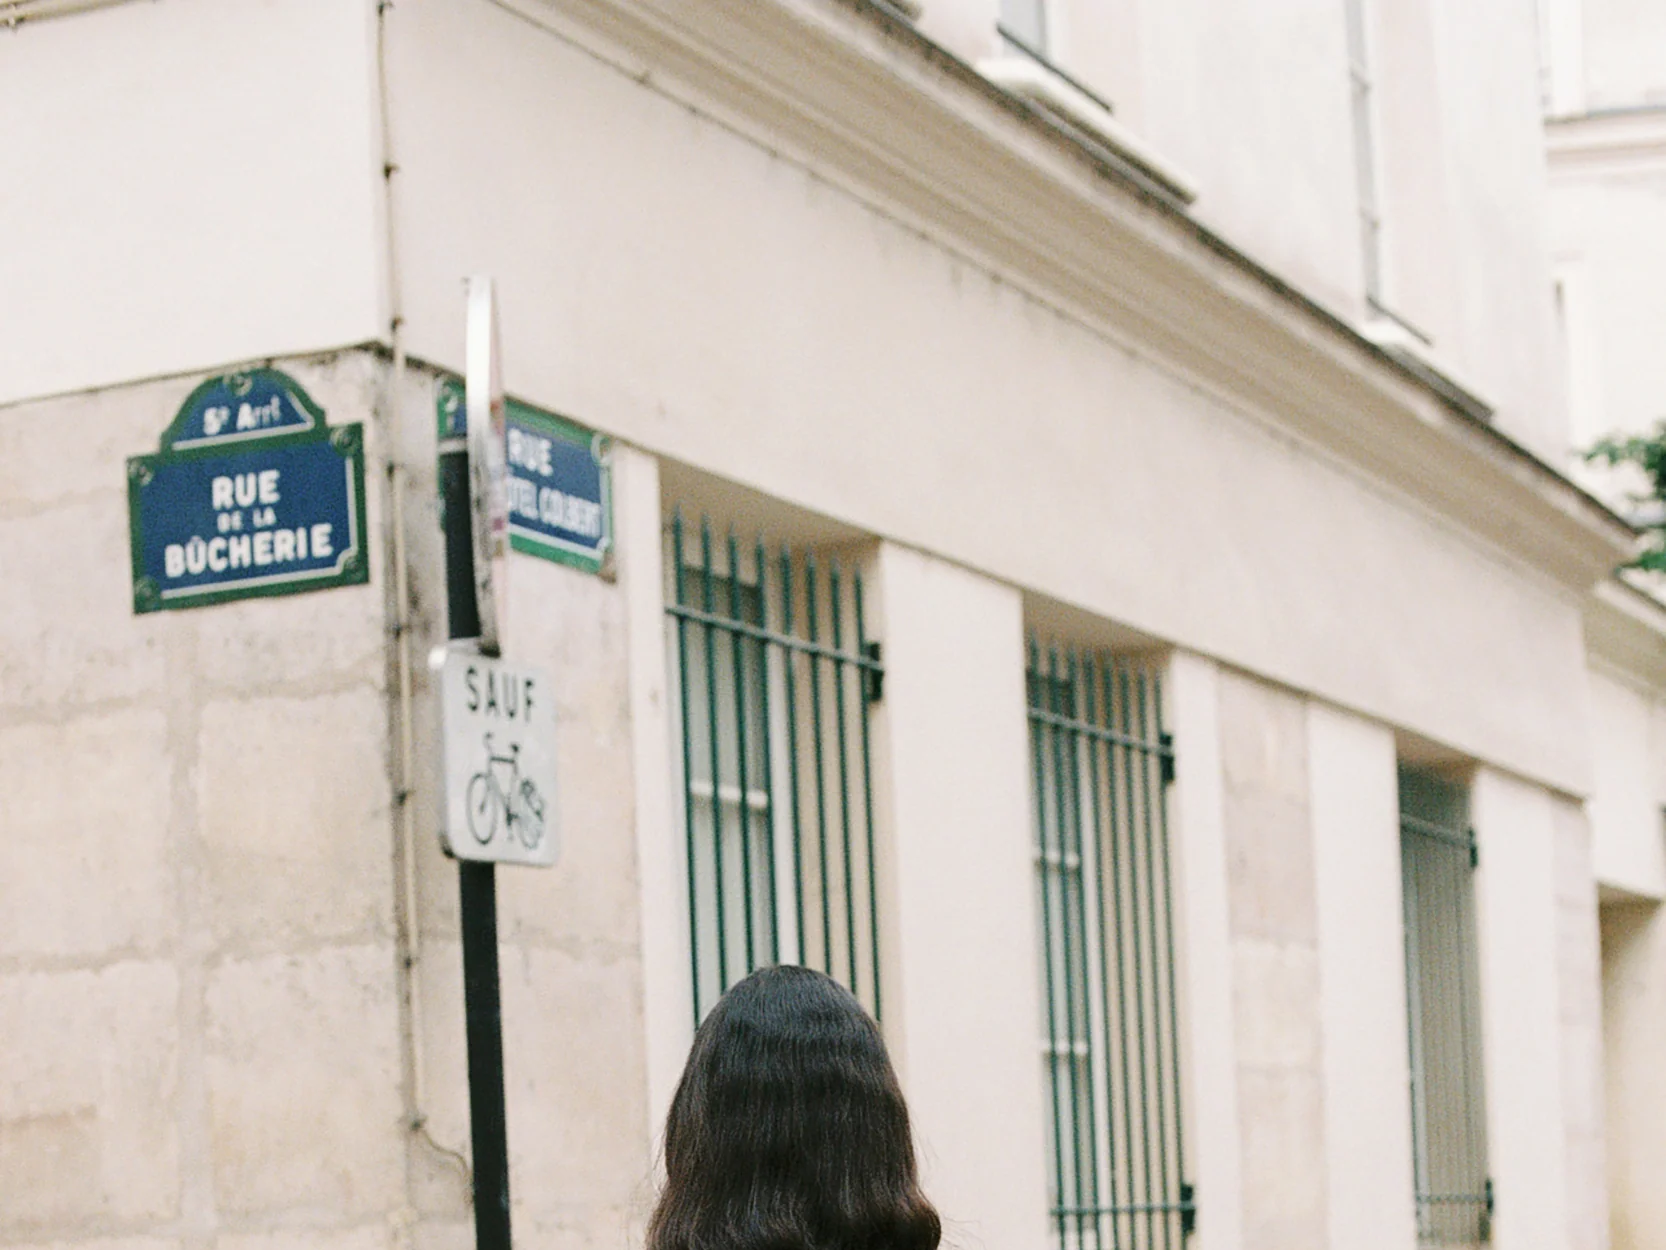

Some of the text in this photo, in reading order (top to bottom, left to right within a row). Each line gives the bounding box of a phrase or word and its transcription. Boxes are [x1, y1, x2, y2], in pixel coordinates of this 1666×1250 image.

[508, 428, 554, 477] RUE
[211, 469, 281, 511] RUE
[217, 506, 276, 533] DE LA
[164, 522, 335, 578] BÛCHERIE
[464, 664, 536, 723] SAUF
